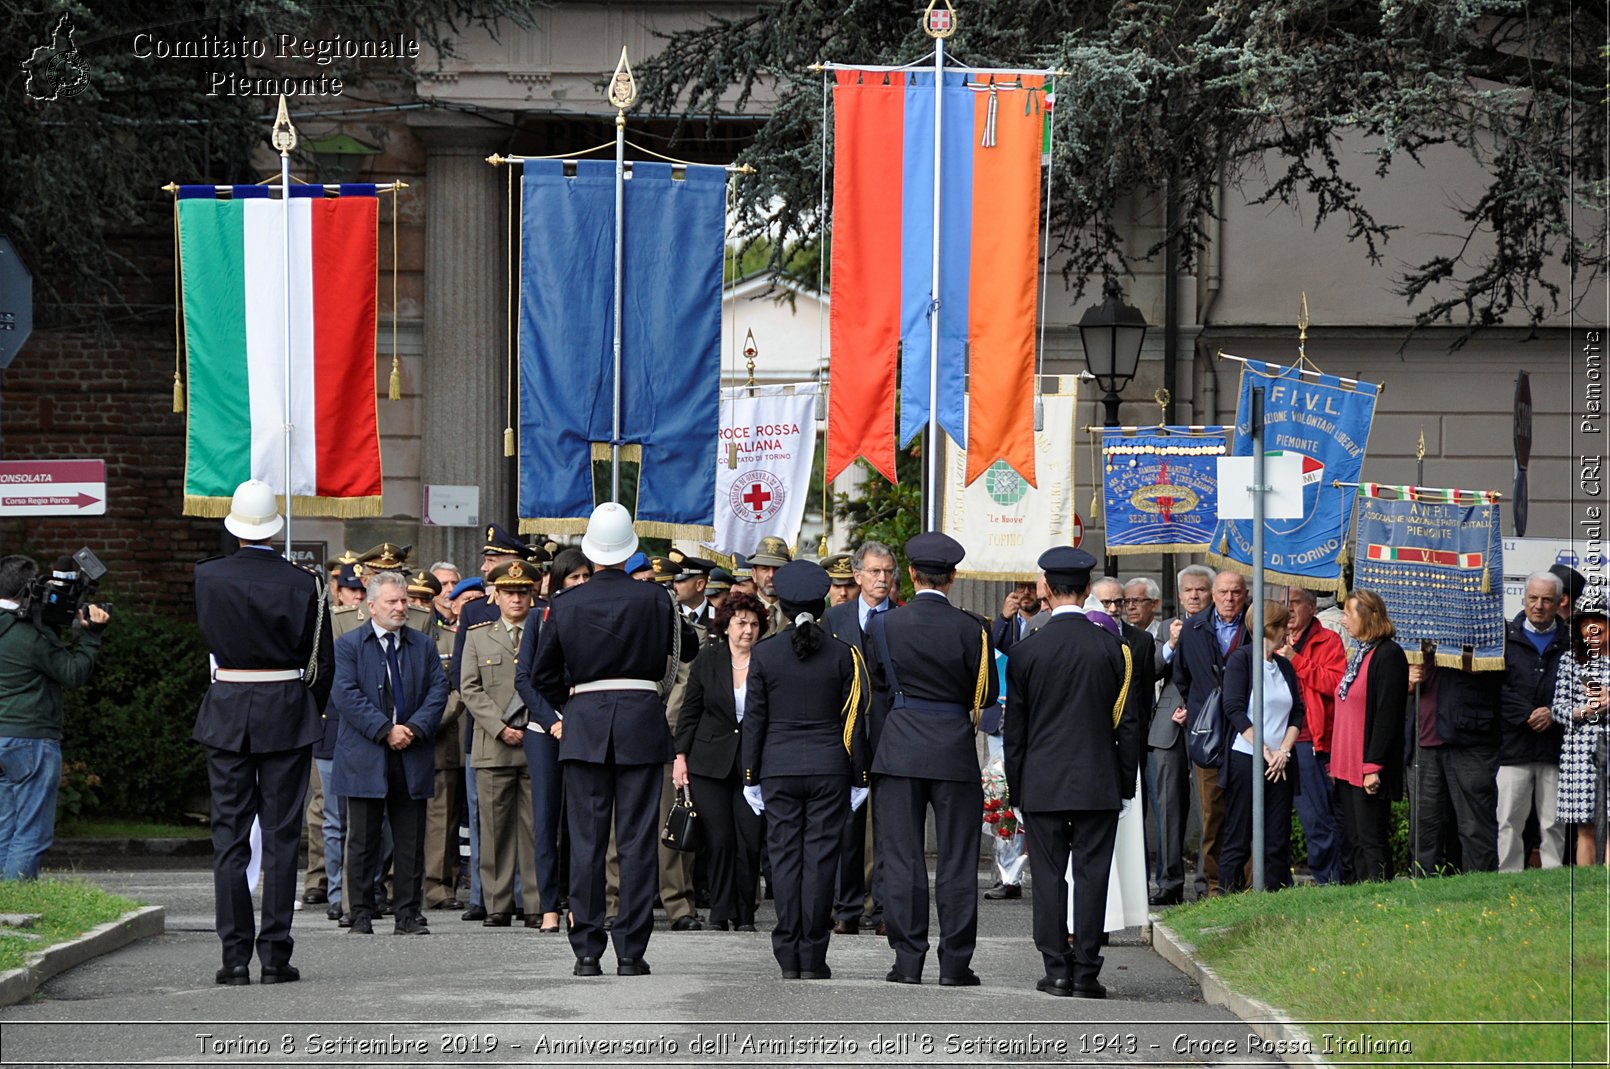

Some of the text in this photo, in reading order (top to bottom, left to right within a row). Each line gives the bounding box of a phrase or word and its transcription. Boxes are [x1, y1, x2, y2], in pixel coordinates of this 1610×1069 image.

[1291, 410, 1336, 435] VOLONTARI
[718, 423, 800, 440] ROCE ROSSA
[725, 439, 782, 454] IALIANA
[1276, 434, 1319, 453] PIEMONTE
[718, 456, 753, 465] COTATO
[765, 453, 791, 461] TORINO
[0, 474, 53, 483] ONSOLATA
[5, 497, 26, 505] Corso
[28, 497, 48, 505] Regio
[1129, 514, 1201, 523] SEDE DI TORINO
[988, 533, 1024, 546] TORINO
[1271, 553, 1284, 565] DI
[1288, 539, 1339, 565] TORINO
